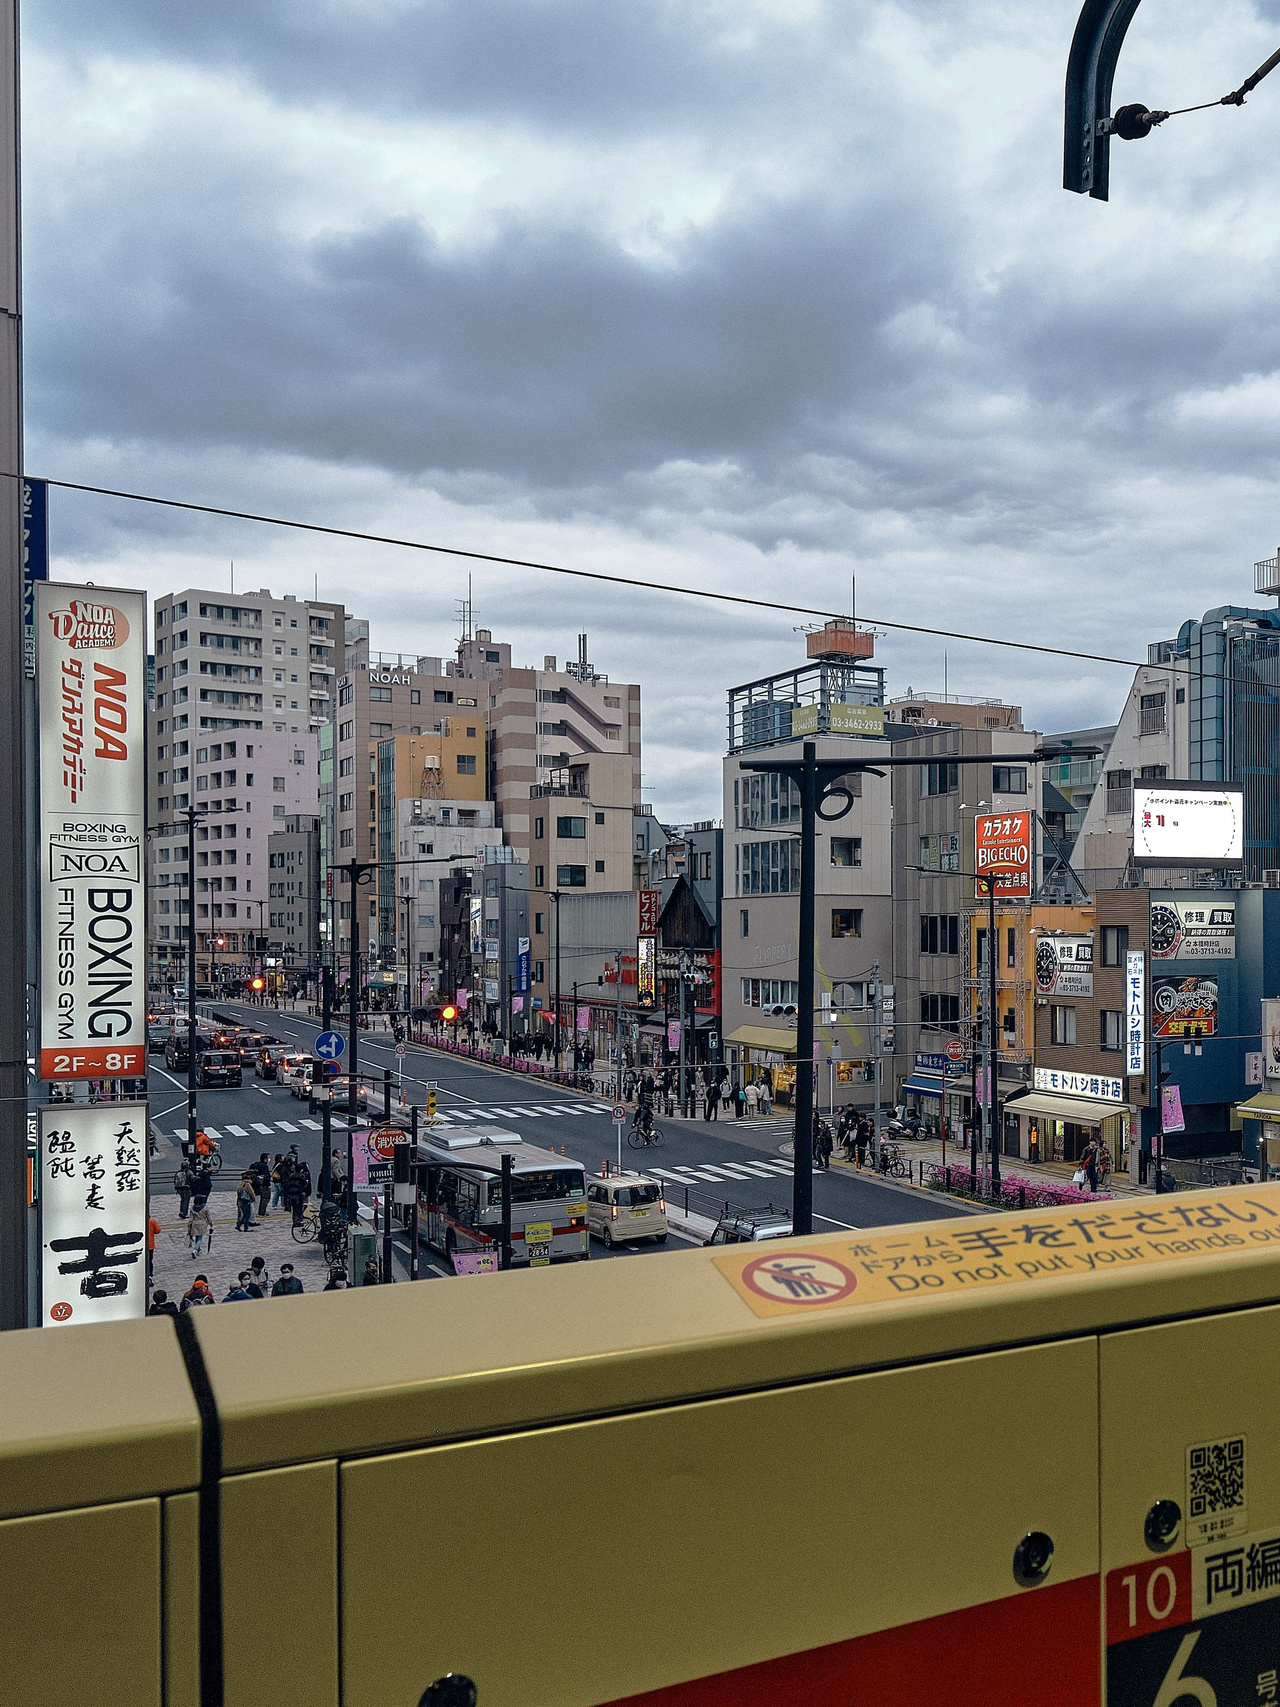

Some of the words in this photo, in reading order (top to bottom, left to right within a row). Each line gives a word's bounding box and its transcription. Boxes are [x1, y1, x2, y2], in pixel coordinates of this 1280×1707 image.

[52, 610, 115, 640] Dance
[75, 601, 115, 625] NOA
[75, 637, 115, 649] ACADEMY
[369, 672, 411, 686] NOAH
[94, 661, 128, 761] NOA
[50, 833, 108, 843] FITNESS
[112, 834, 139, 844] GYM
[63, 823, 126, 834] BOXING
[983, 818, 1023, 837] カラオケ
[60, 855, 129, 872] NOA
[641, 893, 651, 931] ヒノマル
[1184, 911, 1205, 923] 修理
[1213, 911, 1232, 923] 買取
[58, 888, 74, 986] FITNESS
[88, 888, 132, 1038] BOXING
[58, 992, 74, 1040] GYM
[1130, 977, 1141, 1070] モトハシ時計店
[1050, 1073, 1121, 1098] モトハシ時計店
[951, 1200, 1278, 1259] 手をださない
[849, 1234, 951, 1259] ホーム
[860, 1249, 965, 1276] ドアから
[886, 1271, 946, 1292] Do
[951, 1263, 1003, 1285] not
[1015, 1256, 1074, 1279] put
[1074, 1244, 1145, 1271] your
[1151, 1232, 1245, 1257] hands
[1121, 1566, 1177, 1628] 10
[1255, 1669, 1279, 1707] 号
